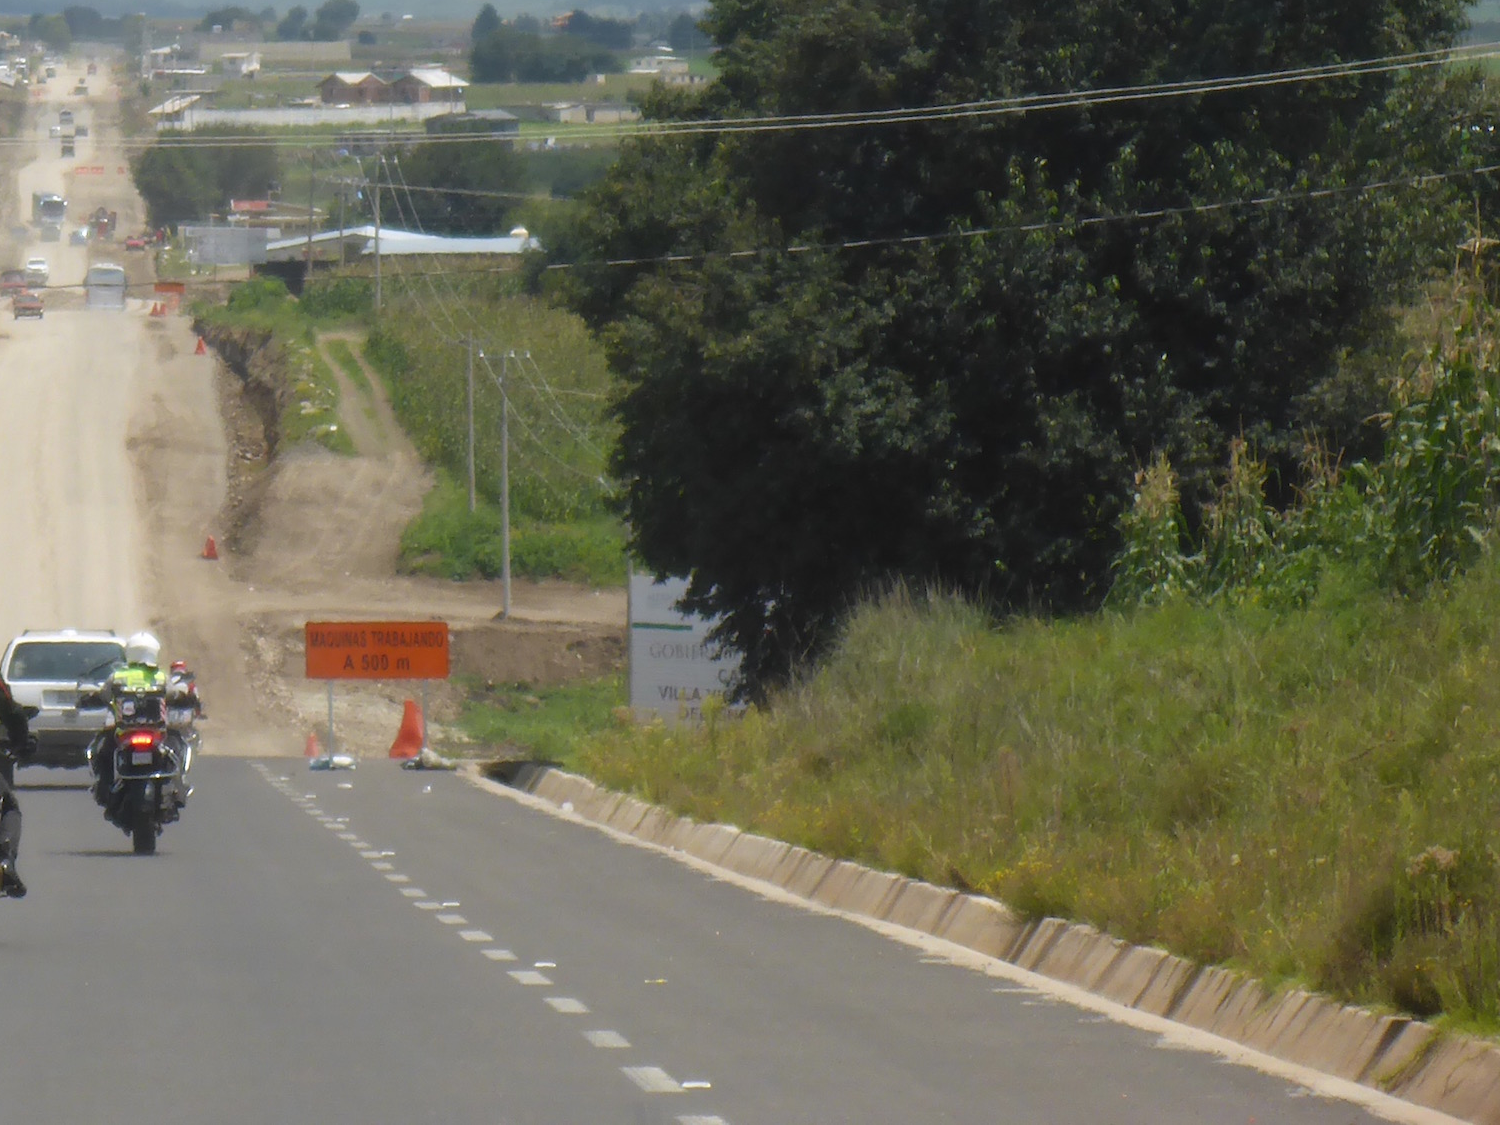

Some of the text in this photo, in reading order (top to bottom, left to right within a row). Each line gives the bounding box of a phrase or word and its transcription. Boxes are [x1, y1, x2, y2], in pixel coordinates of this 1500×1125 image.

[371, 630, 444, 648] TRABAJANDO
[343, 654, 411, 671] A 500 m
